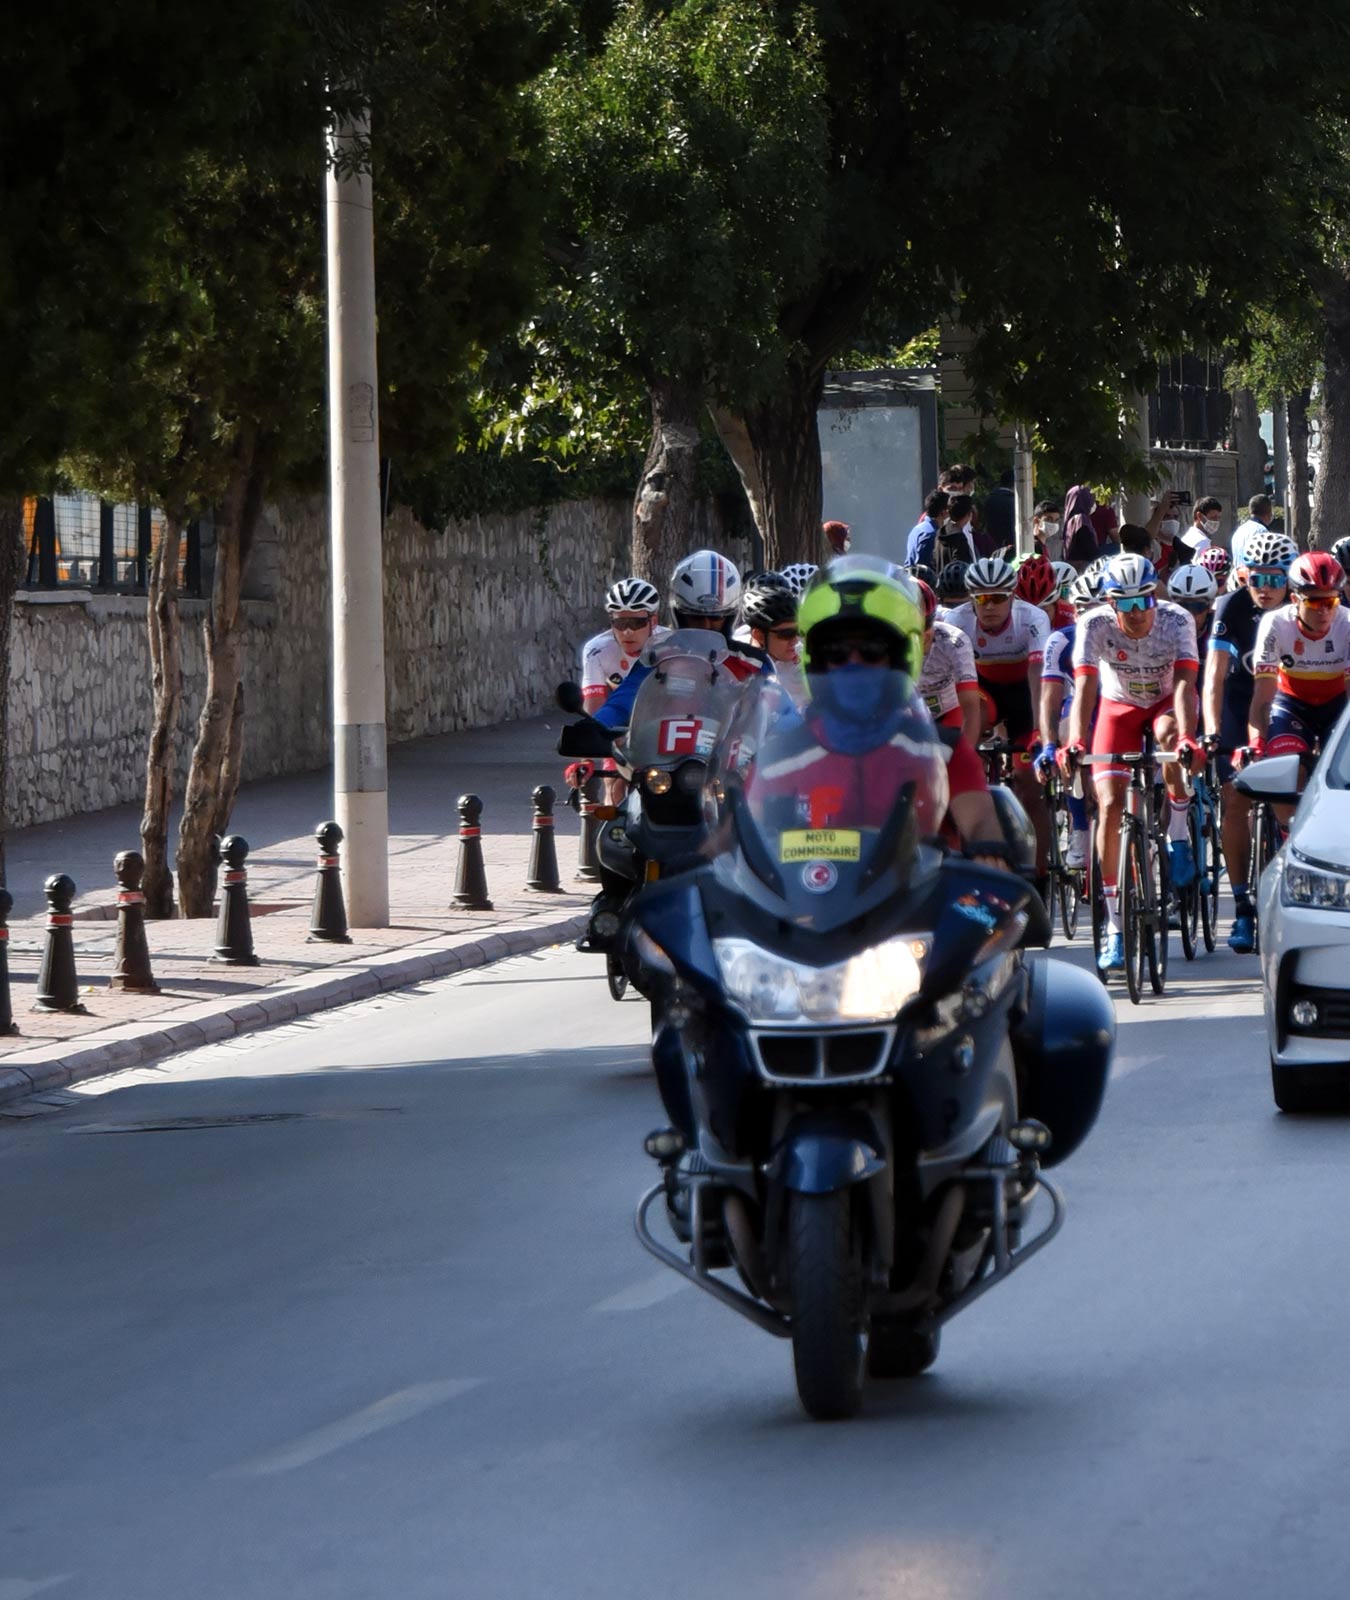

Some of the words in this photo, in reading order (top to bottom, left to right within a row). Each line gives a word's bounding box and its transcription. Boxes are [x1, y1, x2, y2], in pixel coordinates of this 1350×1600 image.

[666, 721, 695, 752] F
[805, 831, 837, 842] MOTO
[783, 847, 859, 858] COMMISSAIRE
